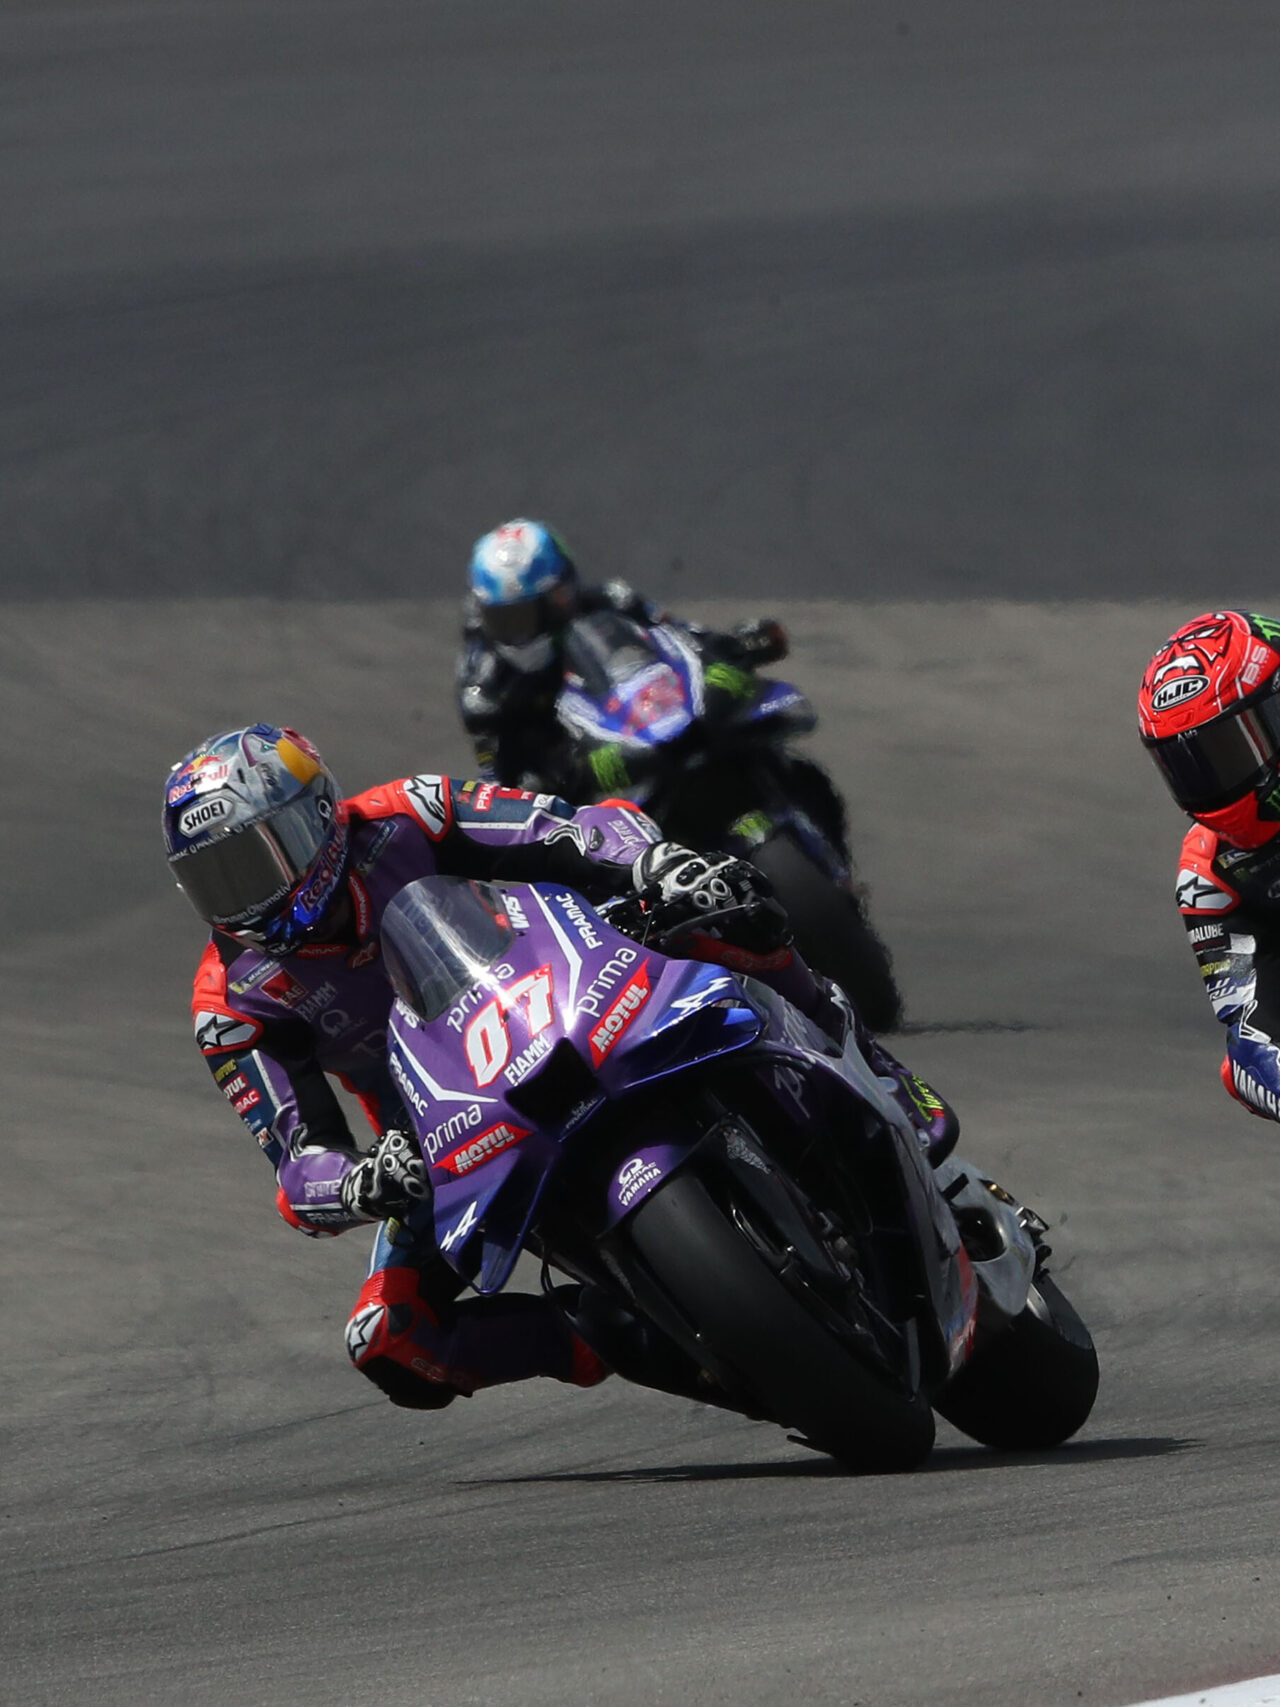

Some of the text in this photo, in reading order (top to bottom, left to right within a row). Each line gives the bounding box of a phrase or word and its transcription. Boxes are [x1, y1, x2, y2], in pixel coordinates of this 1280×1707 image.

[1158, 679, 1199, 705] HJC
[184, 801, 225, 831] SHOEI
[501, 894, 530, 930] WRS
[556, 892, 603, 950] PRAMAC
[296, 981, 339, 1022] FIAMM
[577, 946, 639, 1018] prima
[464, 963, 555, 1089] 07
[590, 984, 649, 1053] MOTUL
[389, 1051, 428, 1117] PRAMAC
[503, 1035, 552, 1085] FIAMM
[423, 1103, 483, 1164] prima
[454, 1124, 516, 1174] MOTUL
[620, 1167, 662, 1206] YAMAHA
